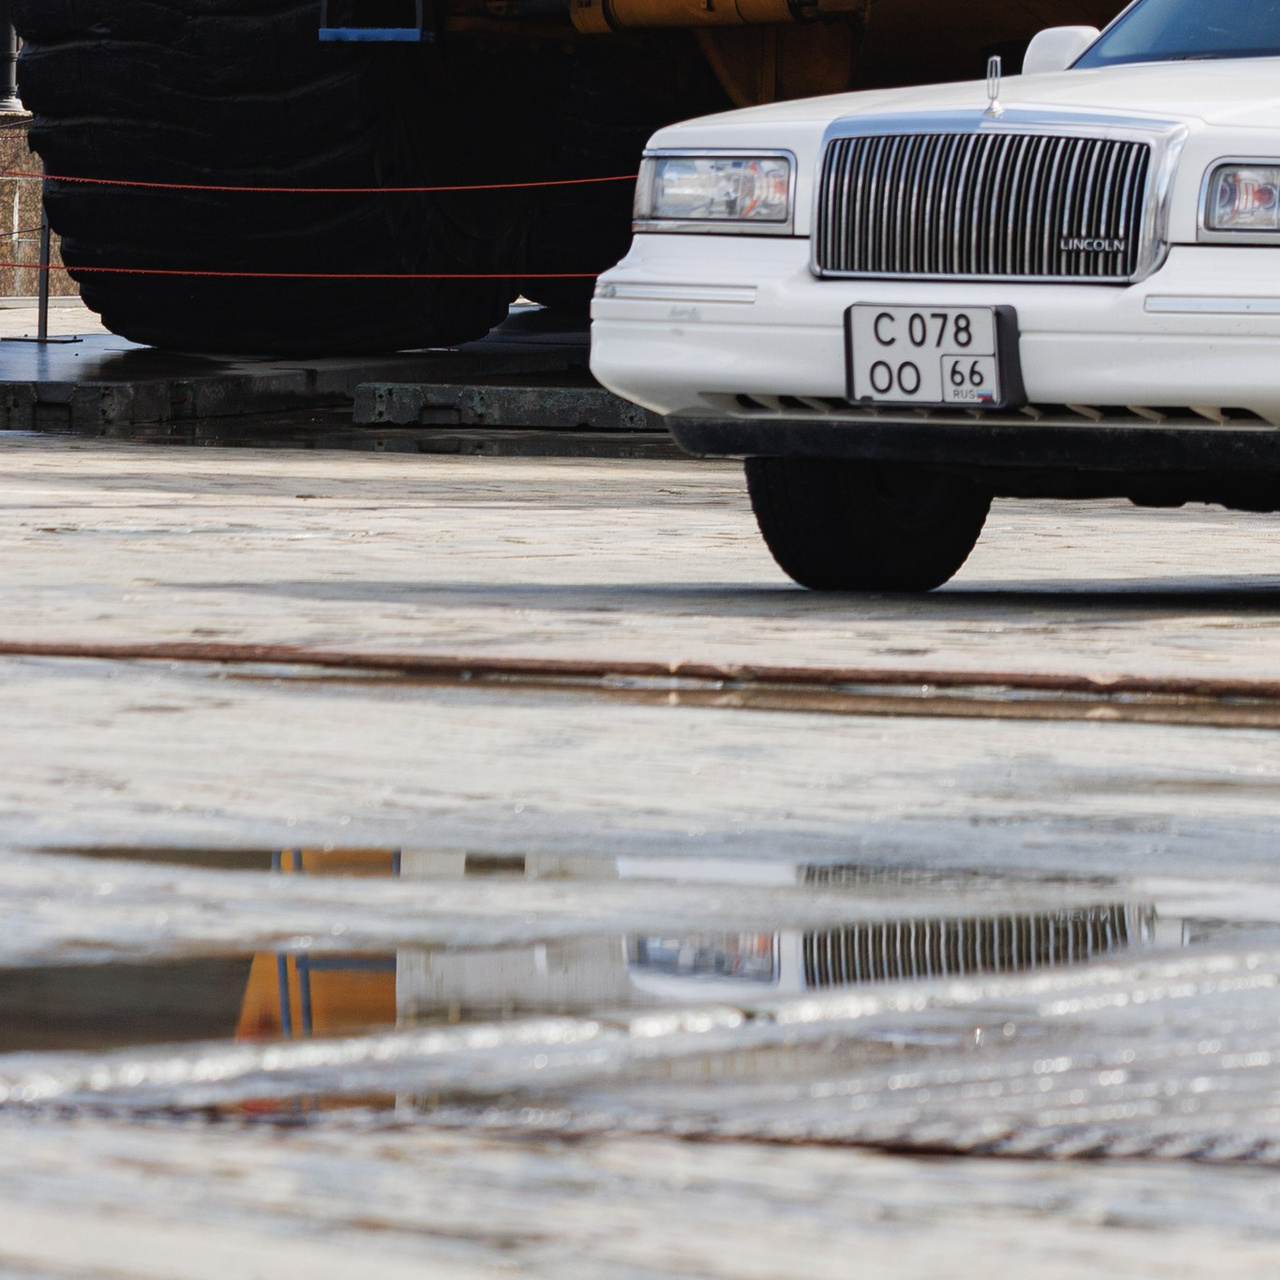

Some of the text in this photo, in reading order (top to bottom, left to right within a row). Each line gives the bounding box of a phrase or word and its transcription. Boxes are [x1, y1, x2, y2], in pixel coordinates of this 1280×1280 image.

[1060, 238, 1125, 251] LINCOLN
[950, 360, 984, 386] 66
[953, 389, 976, 399] RUS
